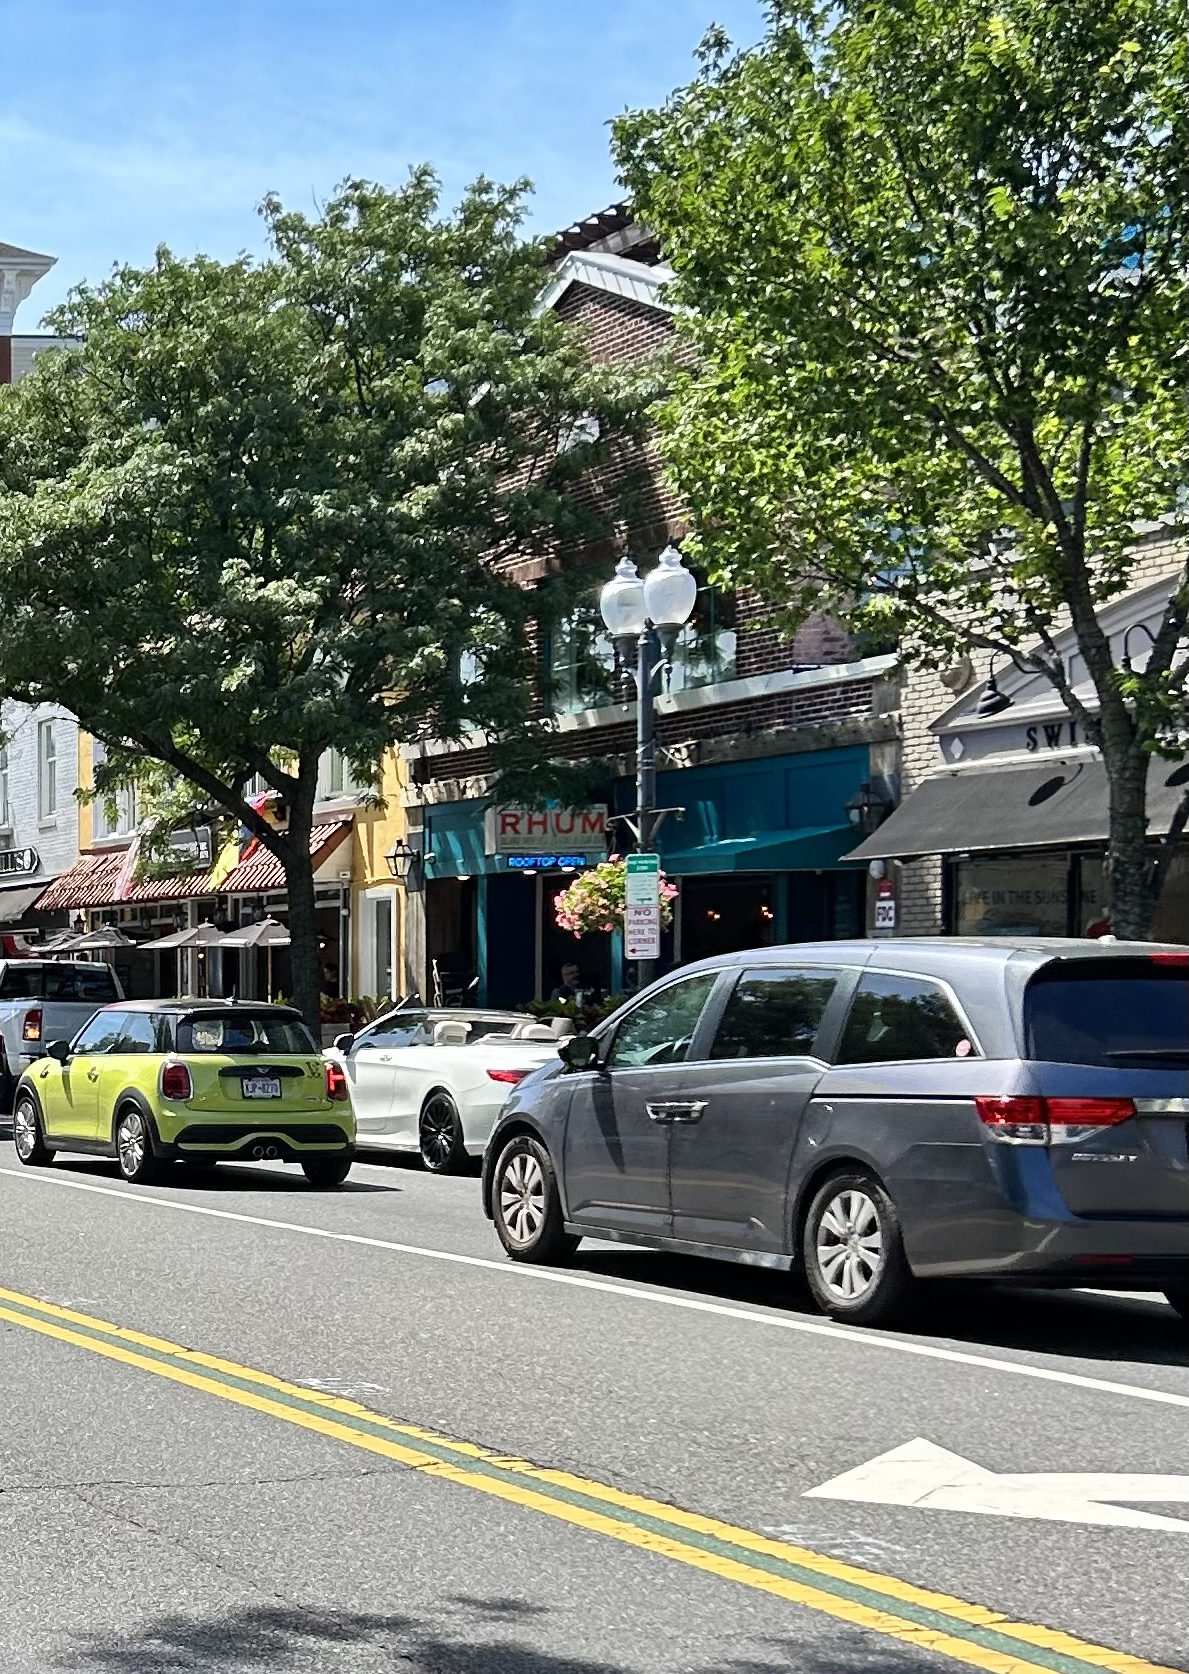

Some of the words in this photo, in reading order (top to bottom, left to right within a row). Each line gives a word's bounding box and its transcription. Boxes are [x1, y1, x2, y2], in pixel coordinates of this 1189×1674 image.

[1027, 720, 1090, 750] SWI
[500, 811, 605, 835] RHUM
[508, 857, 556, 867] ROOFTOP
[558, 857, 585, 867] OPEN
[1008, 889, 1032, 904] THE
[633, 909, 652, 917] NO
